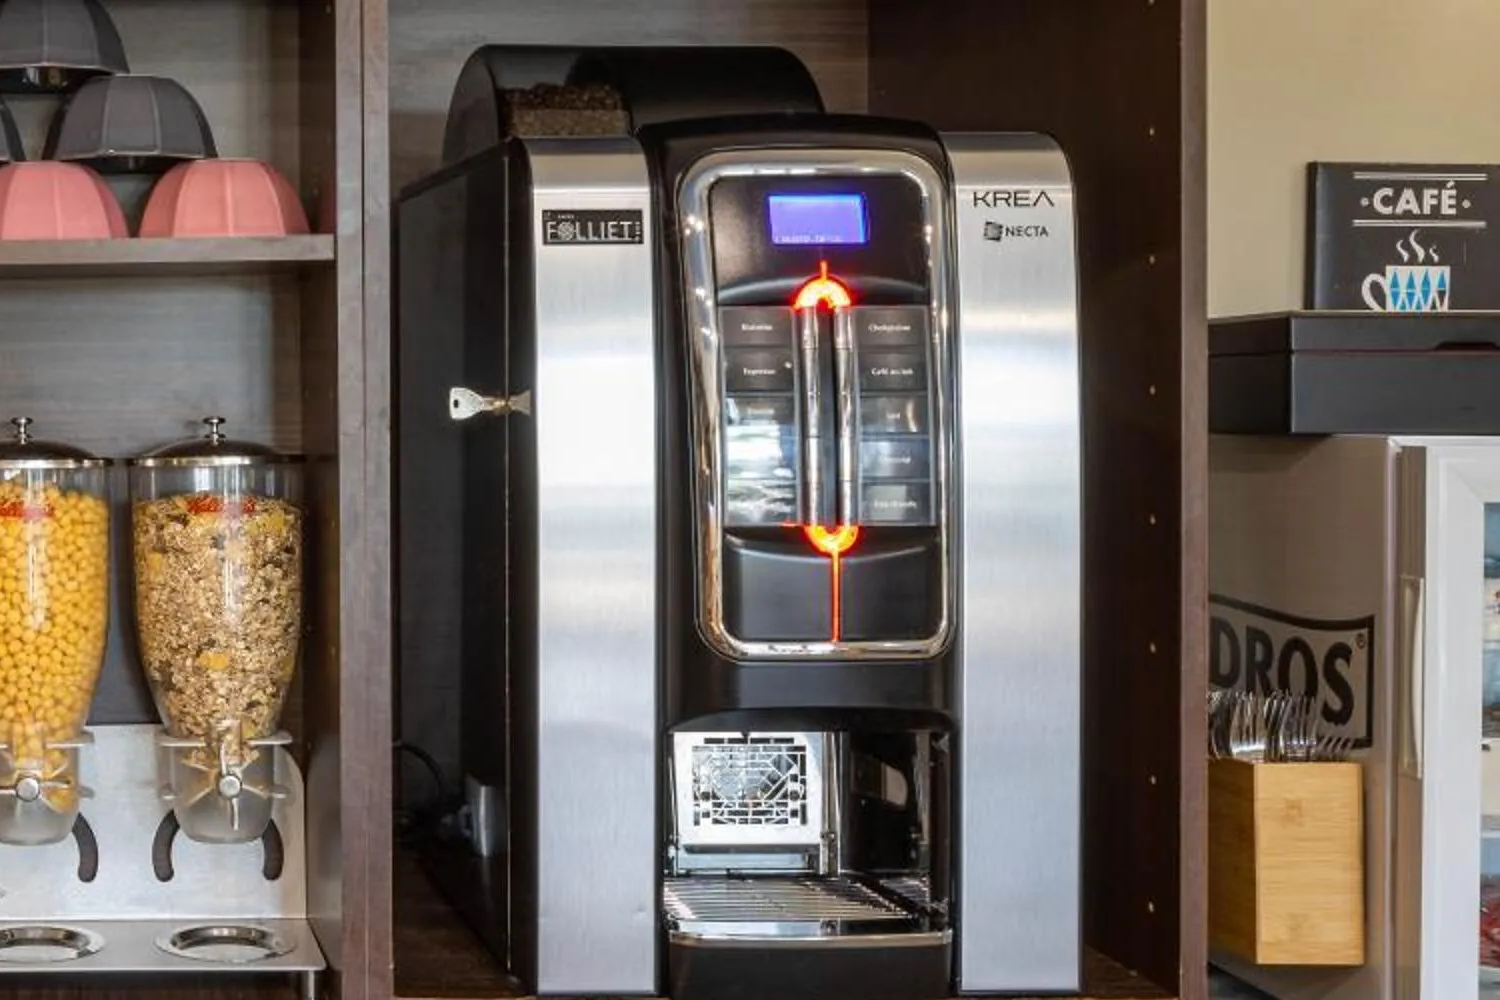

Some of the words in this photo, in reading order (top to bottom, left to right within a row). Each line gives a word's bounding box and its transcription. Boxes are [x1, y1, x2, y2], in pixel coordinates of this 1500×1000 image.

[973, 190, 1055, 207] KREA
[1373, 180, 1457, 215] CAFÉ
[1005, 225, 1049, 237] NECTA
